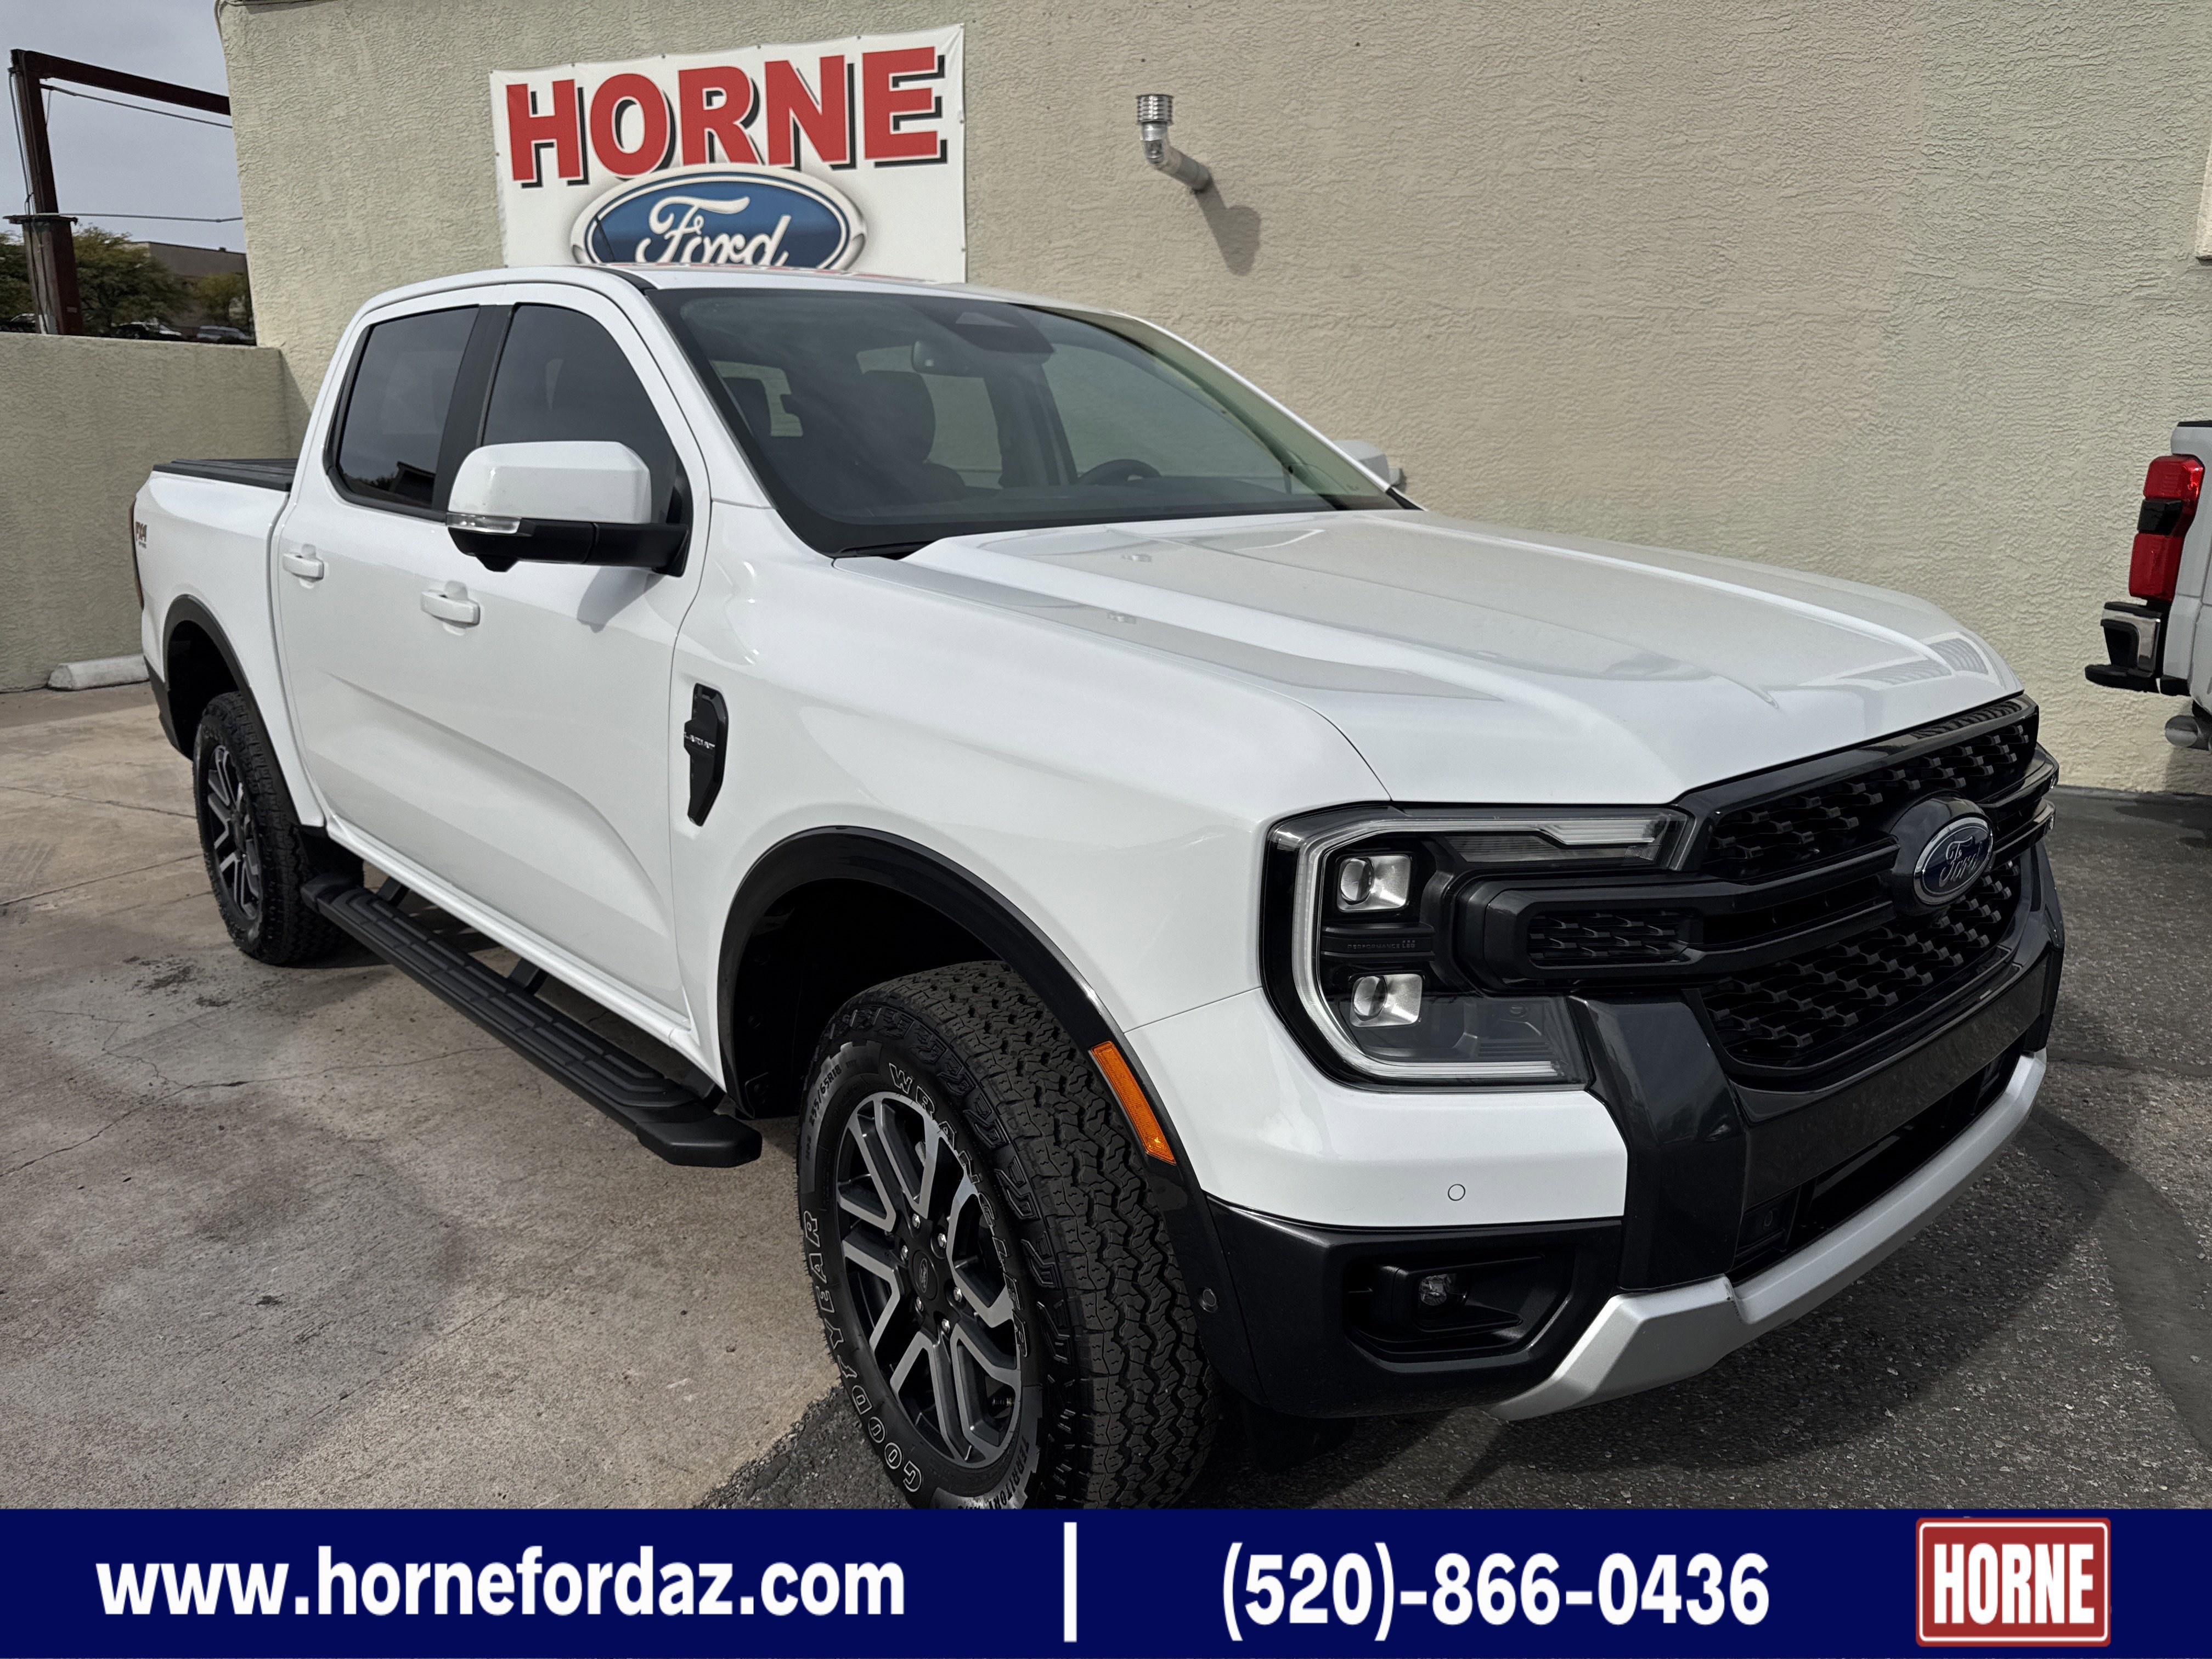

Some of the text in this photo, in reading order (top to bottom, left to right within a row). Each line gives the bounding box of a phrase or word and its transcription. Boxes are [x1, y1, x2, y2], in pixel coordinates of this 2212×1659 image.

[506, 46, 947, 188] HORNE
[635, 196, 791, 266] Ford
[1938, 836, 1983, 888] Ford
[803, 1210, 922, 1493] GOODYEAR
